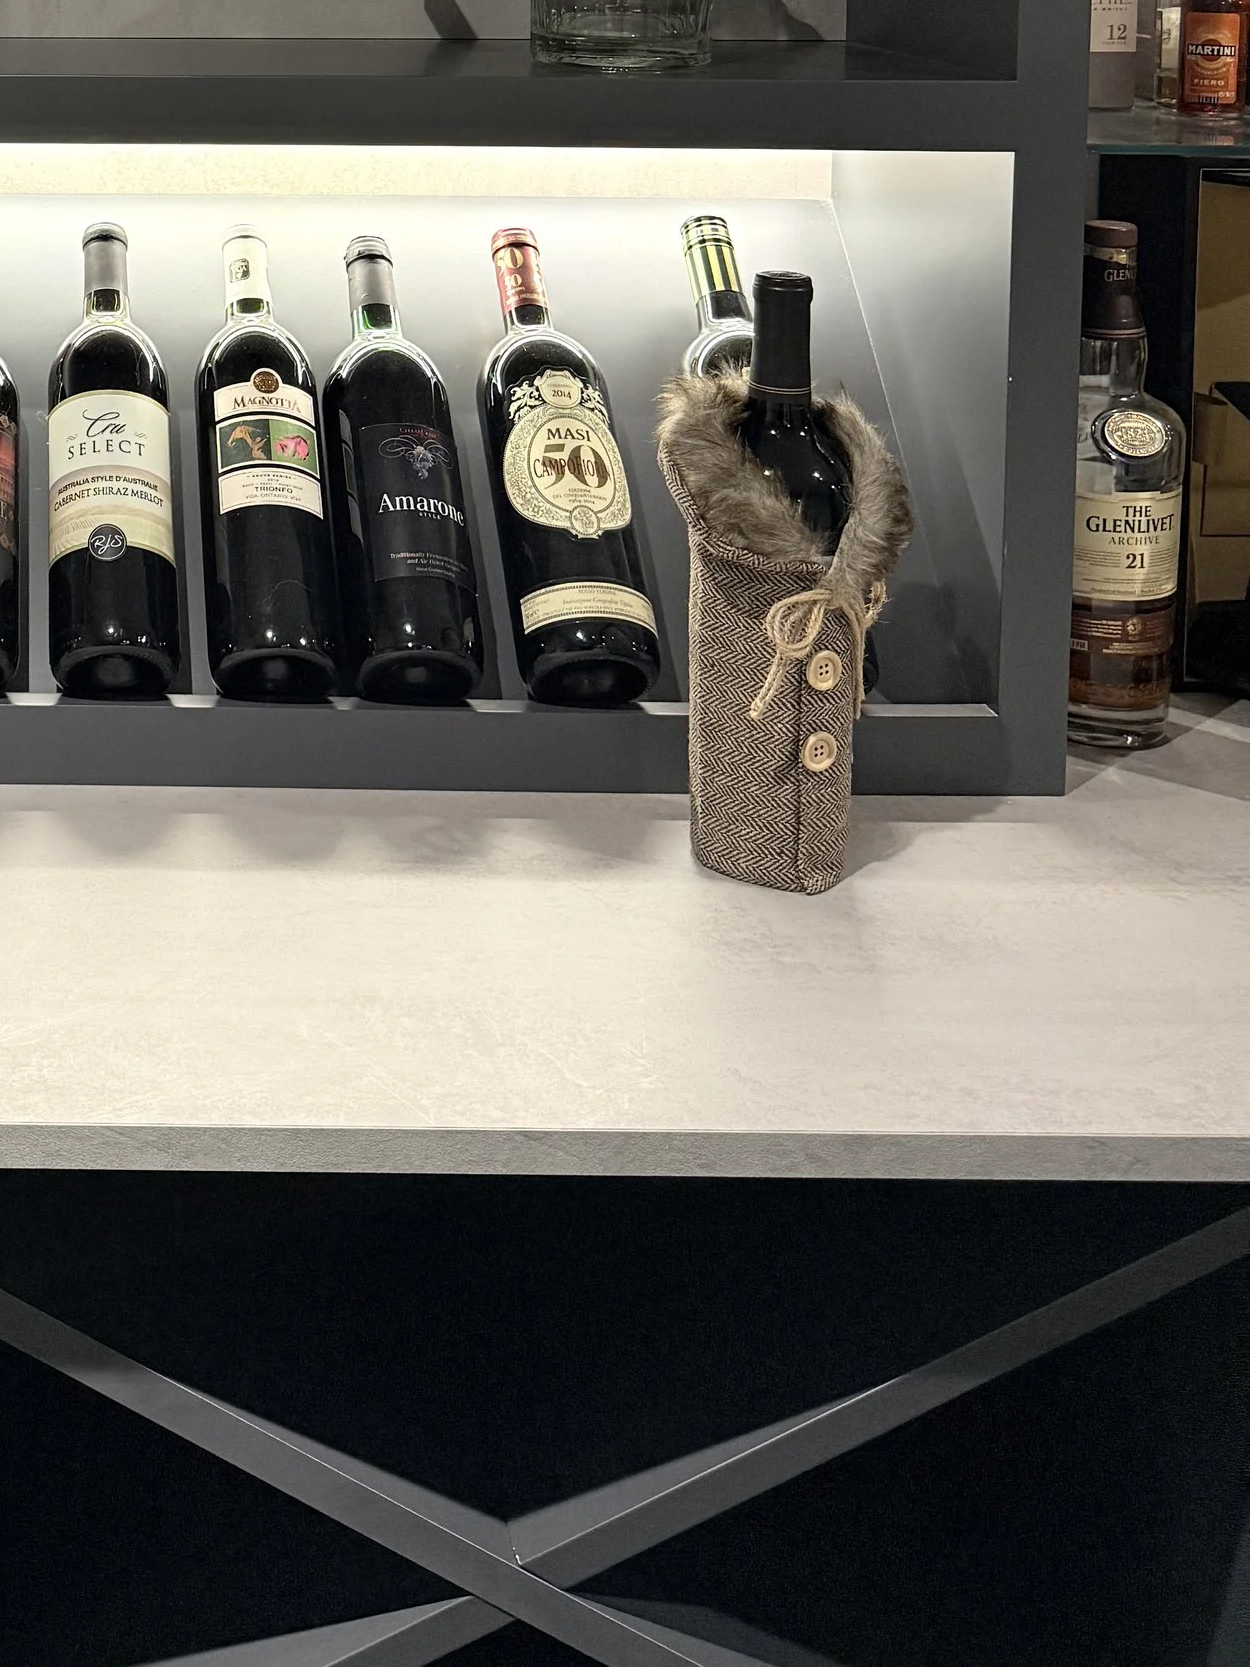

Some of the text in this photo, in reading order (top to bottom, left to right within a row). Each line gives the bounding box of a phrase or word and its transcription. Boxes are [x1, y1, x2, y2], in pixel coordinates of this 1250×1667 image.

[1107, 23, 1128, 41] 12
[1188, 44, 1236, 56] MARTINI
[551, 389, 572, 400] 2014
[82, 409, 127, 438] Cru
[546, 427, 592, 442] MASI
[67, 439, 146, 460] SELECT
[57, 478, 90, 496] AUSTRALIA
[91, 475, 114, 484] STYLE
[54, 486, 164, 512] CABERNET SHIRAZ MERLOT
[377, 492, 465, 527] Amarone
[1122, 505, 1152, 518] THE
[1085, 513, 1175, 534] GLENLIVET
[90, 534, 123, 555] RJS
[1108, 536, 1161, 546] ARCHIVE
[1125, 552, 1146, 569] 21
